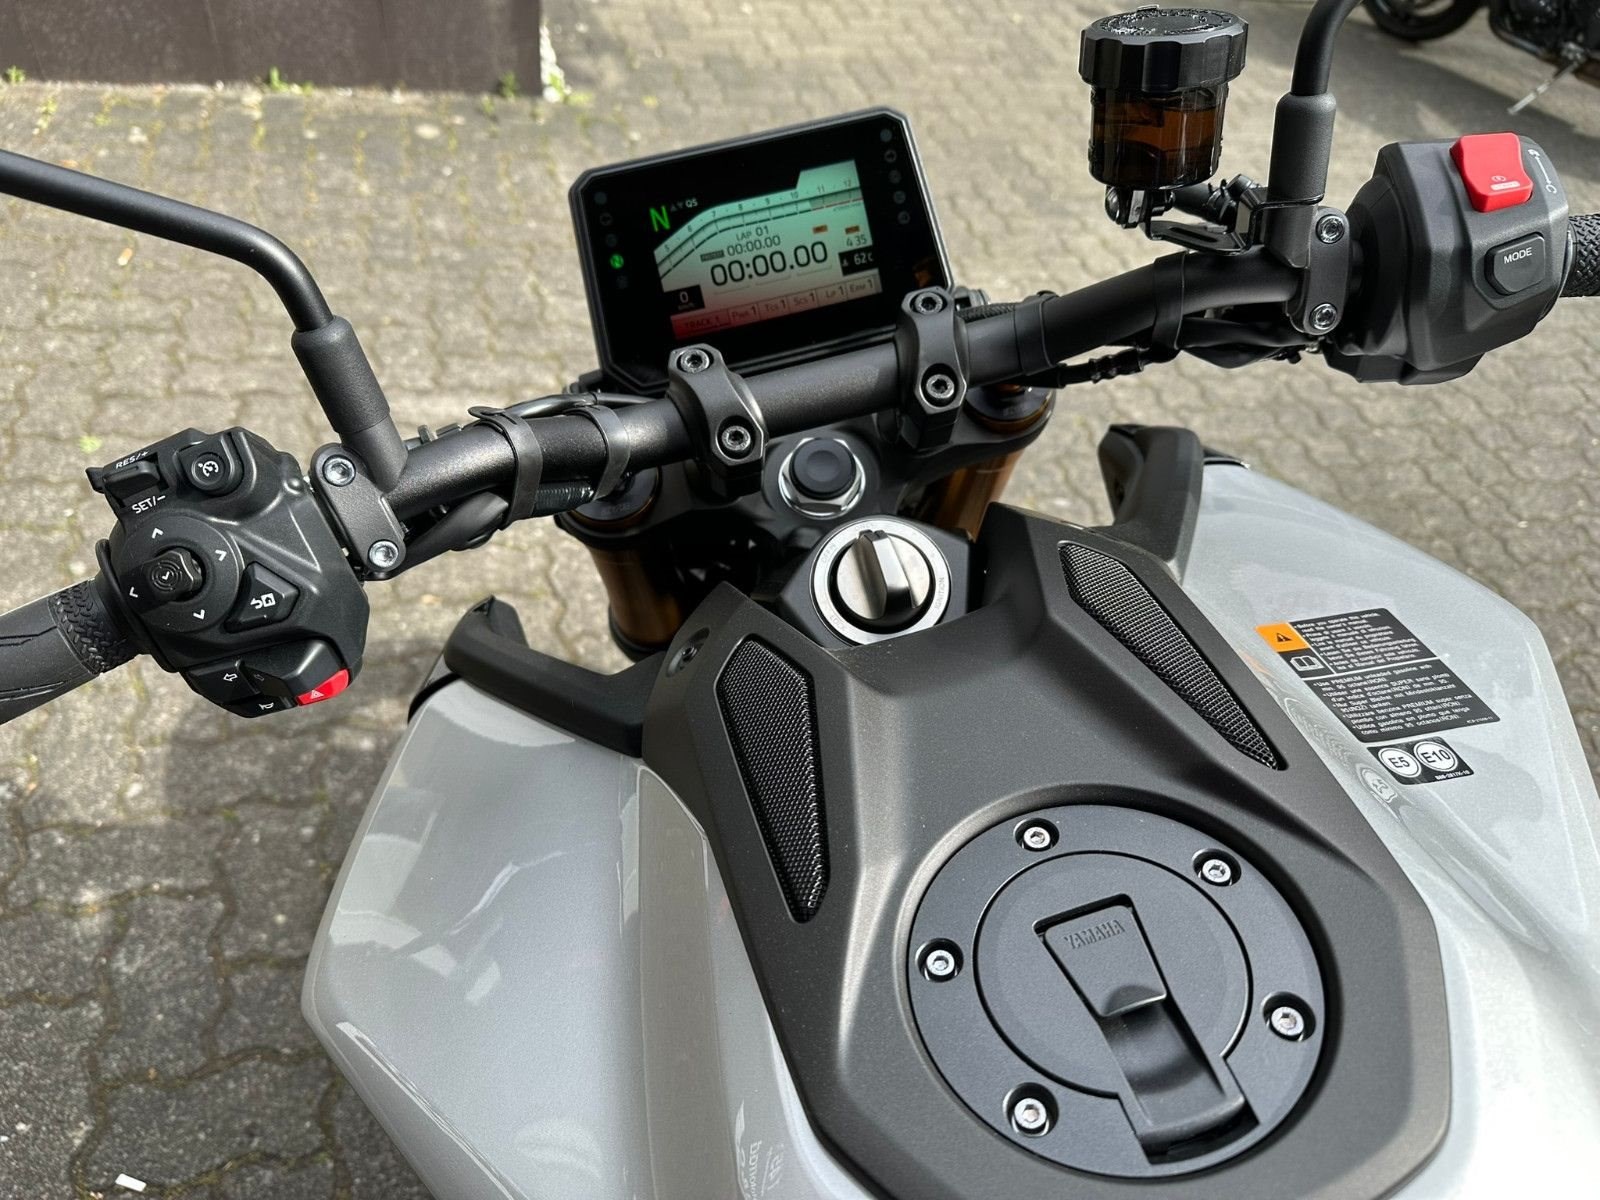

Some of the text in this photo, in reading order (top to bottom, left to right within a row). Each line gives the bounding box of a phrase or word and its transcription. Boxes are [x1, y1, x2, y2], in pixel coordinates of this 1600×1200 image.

[685, 198, 698, 208] QS
[650, 205, 670, 232] N
[736, 225, 769, 242] LAP 01
[726, 235, 781, 257] 00:00.00
[710, 241, 828, 286] 00:00.00
[1503, 247, 1533, 264] MODE
[680, 291, 689, 303] 0
[684, 318, 712, 329] TRACK
[115, 451, 150, 469] RES/+
[132, 495, 166, 514] SET/-
[1390, 748, 1451, 768] E5 E10
[1063, 919, 1126, 950] YAMAHA
